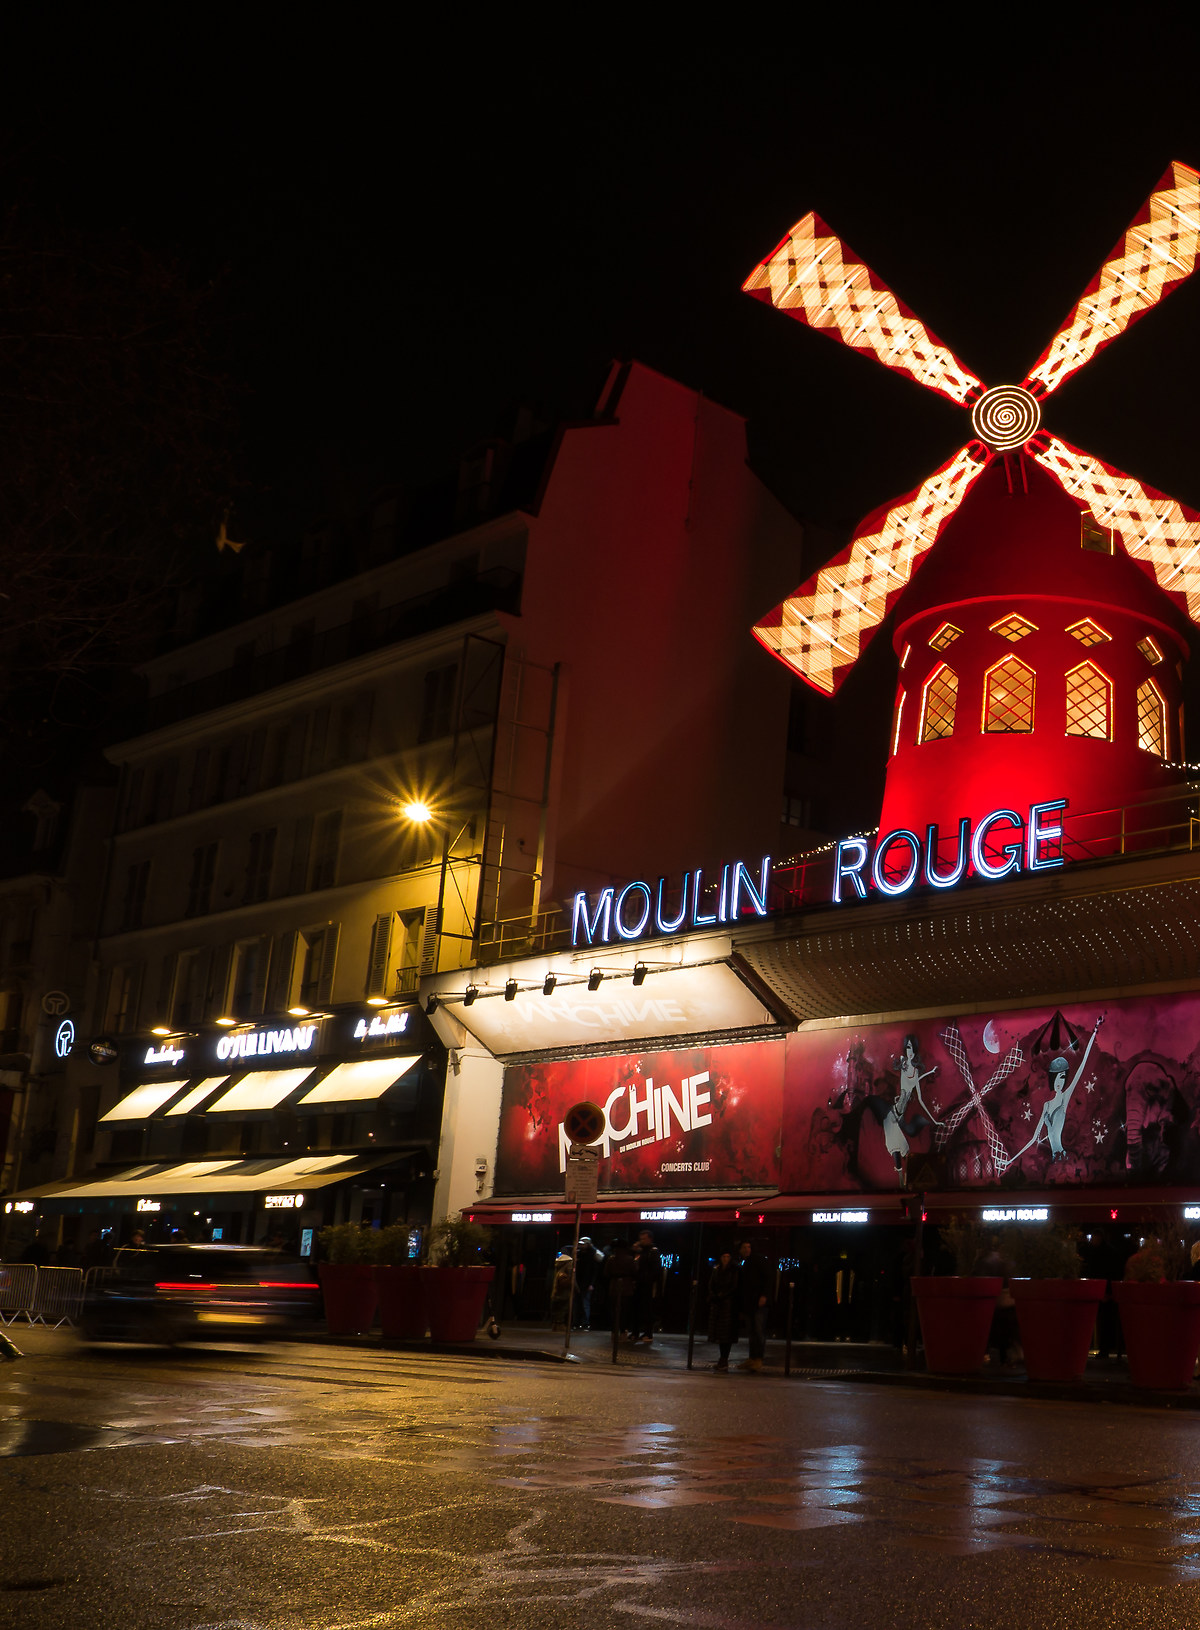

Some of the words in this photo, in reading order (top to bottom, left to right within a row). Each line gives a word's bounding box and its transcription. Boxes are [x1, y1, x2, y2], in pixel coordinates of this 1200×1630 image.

[571, 855, 771, 946] MOULIN
[832, 798, 1068, 903] ROUGE
[661, 1162, 692, 1173] CONCERTS
[693, 1161, 710, 1172] CLUB
[812, 1212, 840, 1223] MOULIN
[982, 1209, 1015, 1221] MOULIN
[1016, 1209, 1048, 1220] ROUGE
